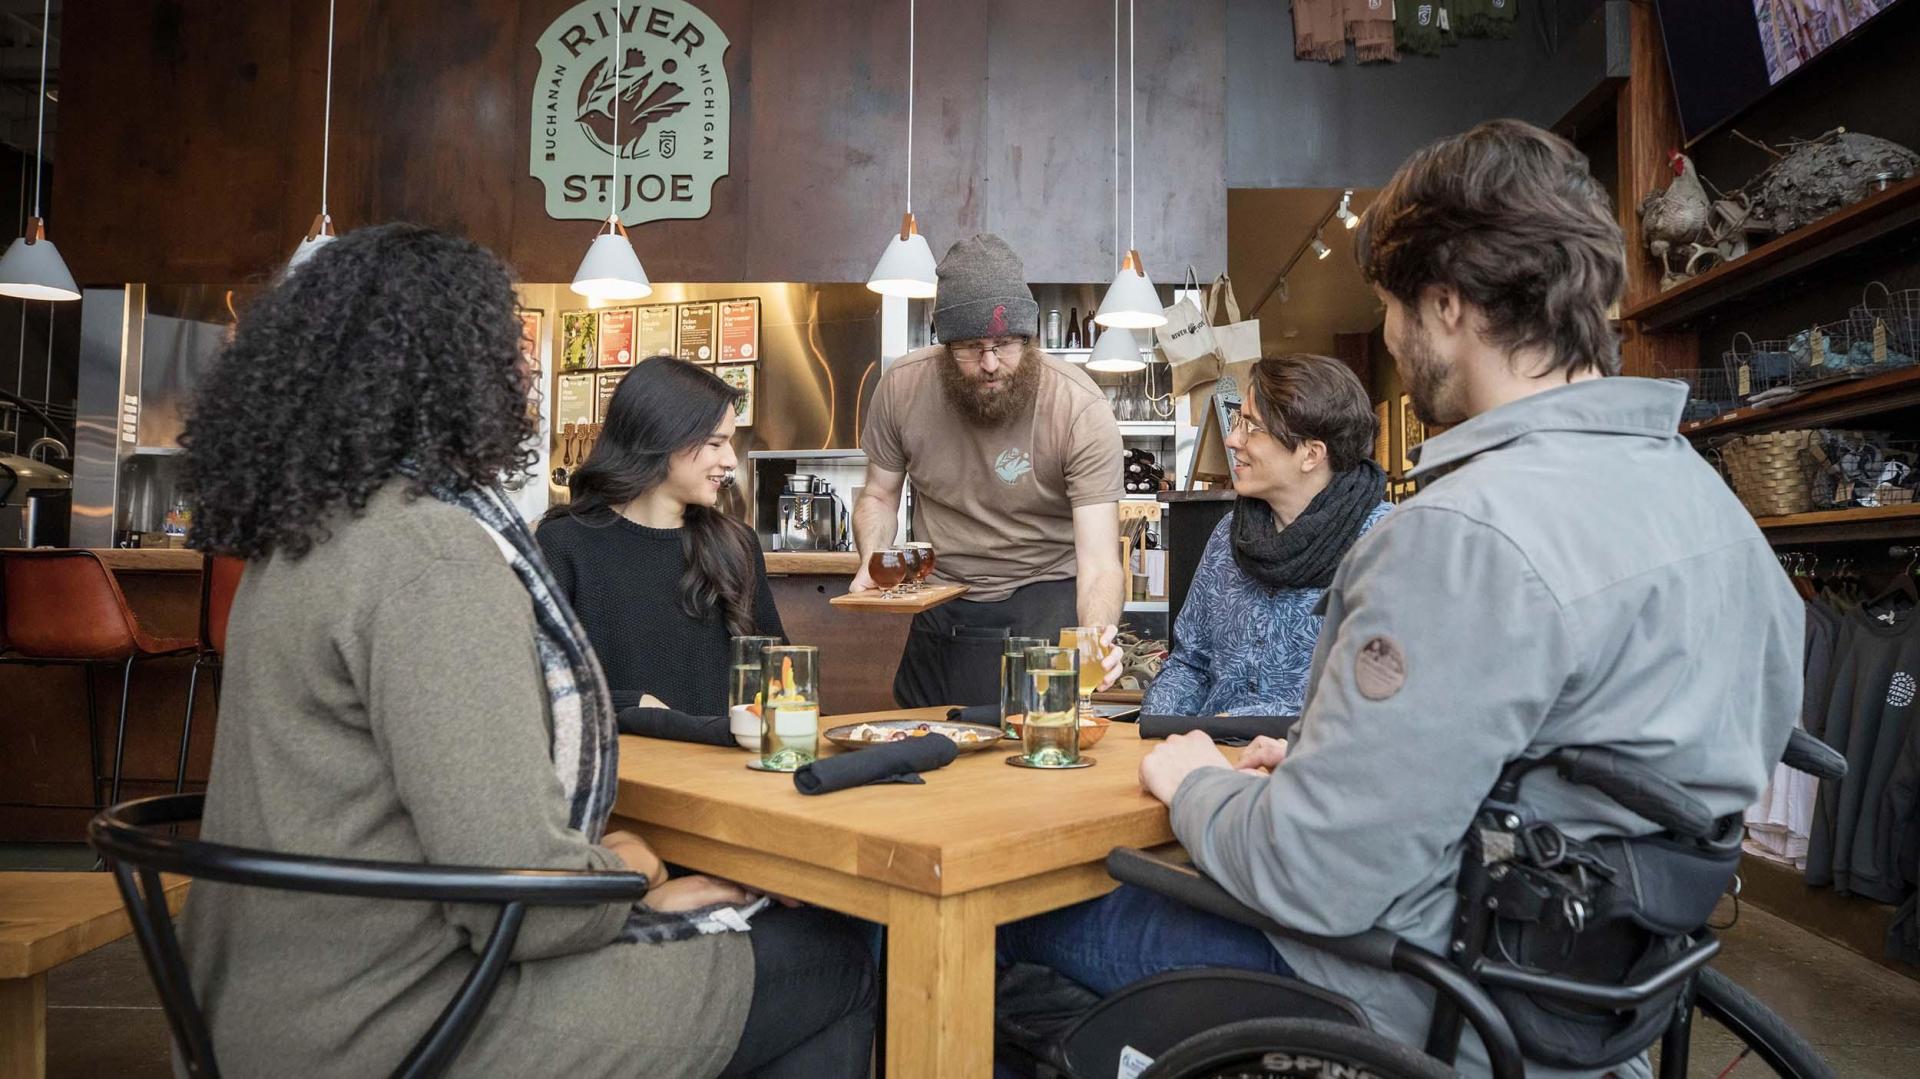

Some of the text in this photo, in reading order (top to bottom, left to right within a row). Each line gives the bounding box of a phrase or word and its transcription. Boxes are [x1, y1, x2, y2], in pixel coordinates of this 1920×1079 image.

[558, 5, 705, 58] RIVER
[545, 64, 567, 161] BUCHANAN
[697, 63, 715, 160] MICHIGAN
[621, 174, 694, 211] JOE
[1171, 329, 1187, 340] RIVER
